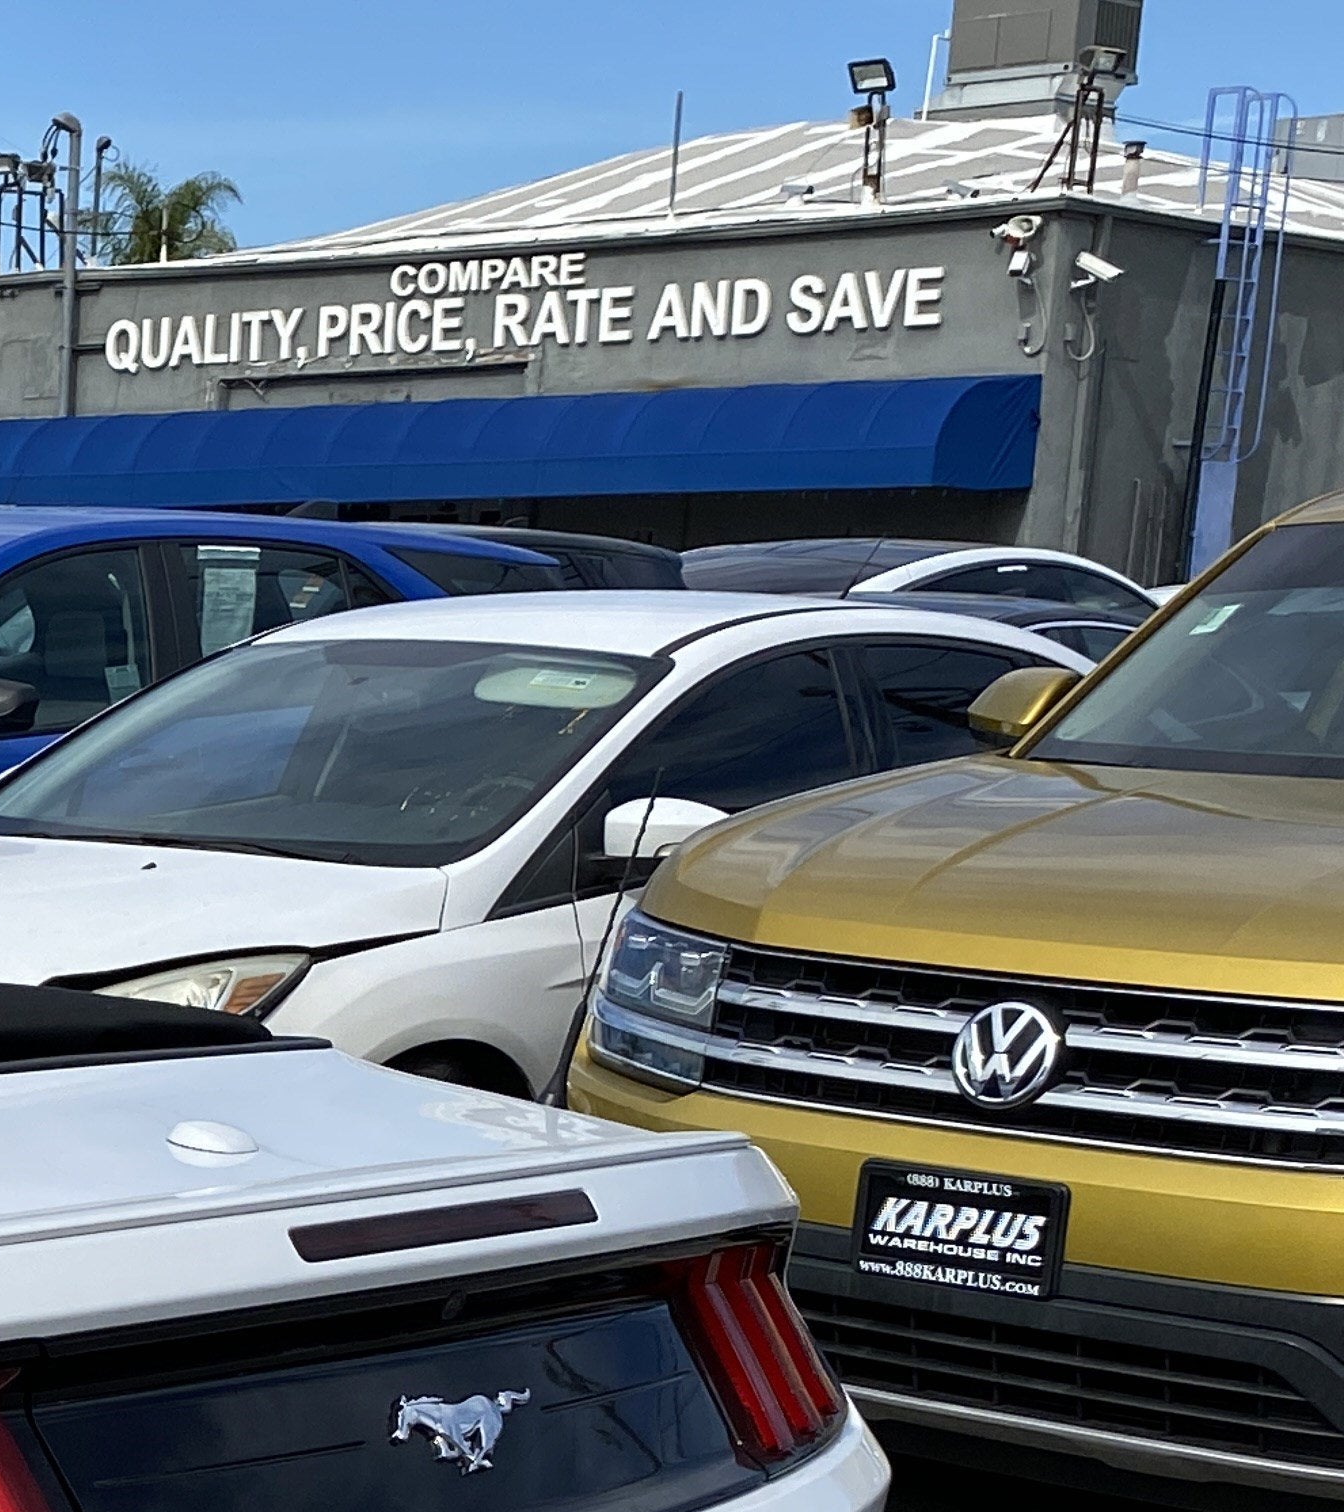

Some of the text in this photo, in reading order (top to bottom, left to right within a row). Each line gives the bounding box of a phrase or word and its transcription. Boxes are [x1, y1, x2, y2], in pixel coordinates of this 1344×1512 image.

[390, 253, 586, 297] COMPARE
[105, 266, 945, 373] QUALITY, PRICE, RATE AND SAVE
[906, 1173, 1012, 1197] (888) KARPLUS
[871, 1196, 1047, 1251] KARPLUS
[868, 1233, 1043, 1267] WAREHOUSE INC
